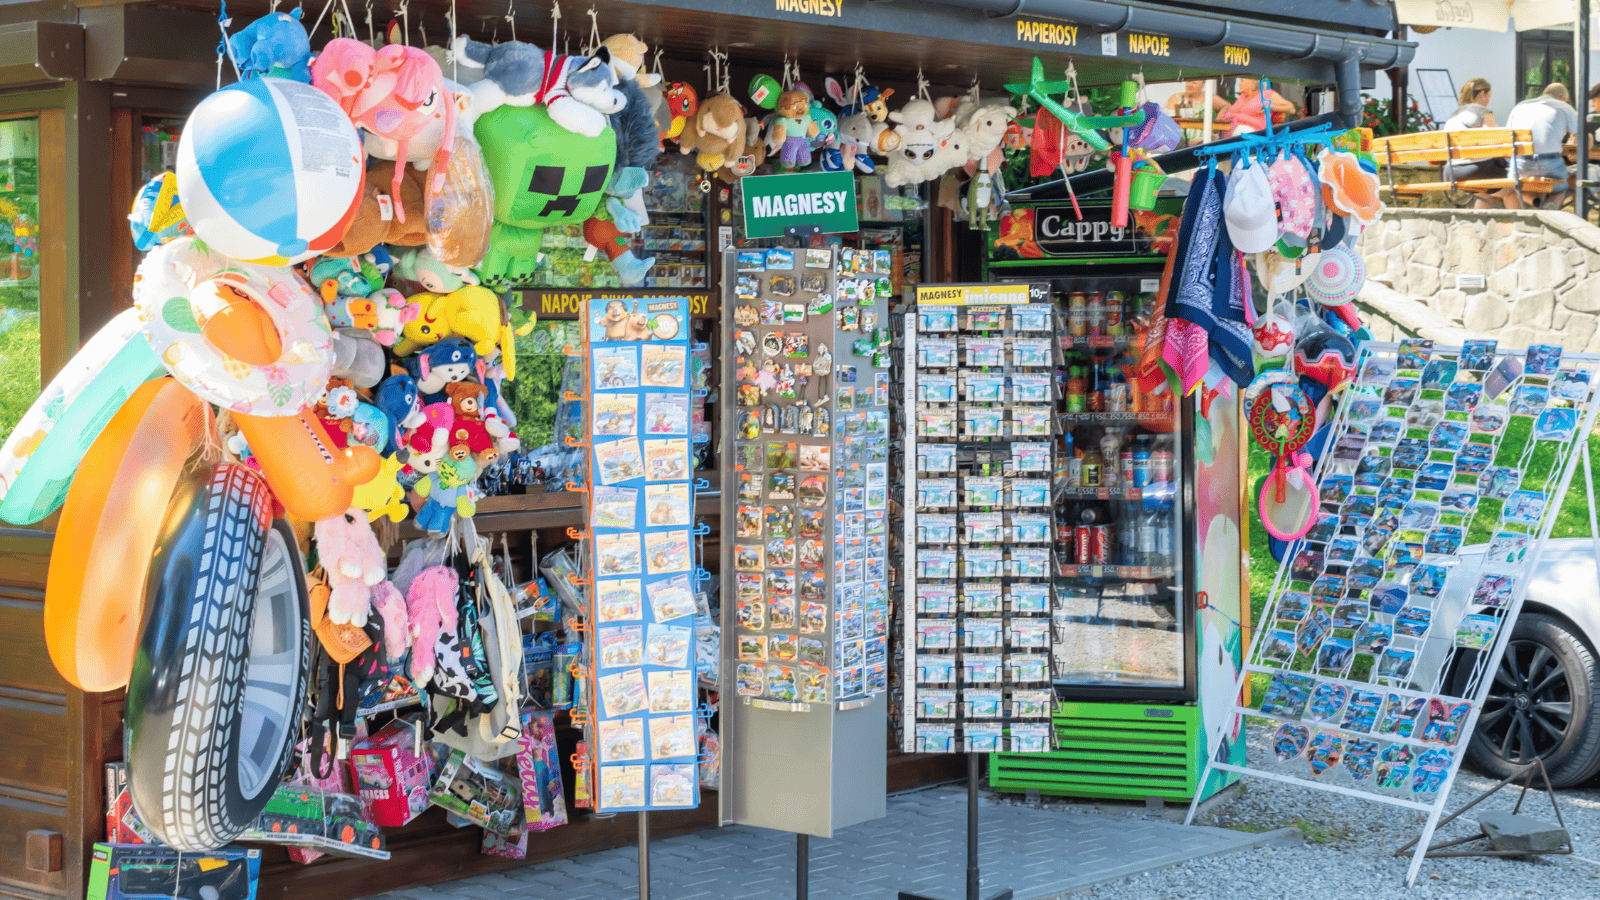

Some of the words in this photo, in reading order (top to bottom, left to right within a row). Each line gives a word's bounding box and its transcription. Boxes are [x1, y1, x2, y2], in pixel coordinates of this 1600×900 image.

[775, 0, 843, 17] MAGNESY
[1017, 20, 1078, 47] PAPIEROSY
[1129, 33, 1170, 57] NAPOJE
[1224, 45, 1251, 66] PIWO
[752, 190, 847, 219] MAGNESY
[1041, 215, 1125, 243] Cappy
[648, 302, 677, 311] MAGNESY
[920, 289, 962, 301] MAGNESY
[964, 288, 1027, 304] imienne
[302, 618, 310, 670] MUD
[278, 676, 306, 778] MASTER
